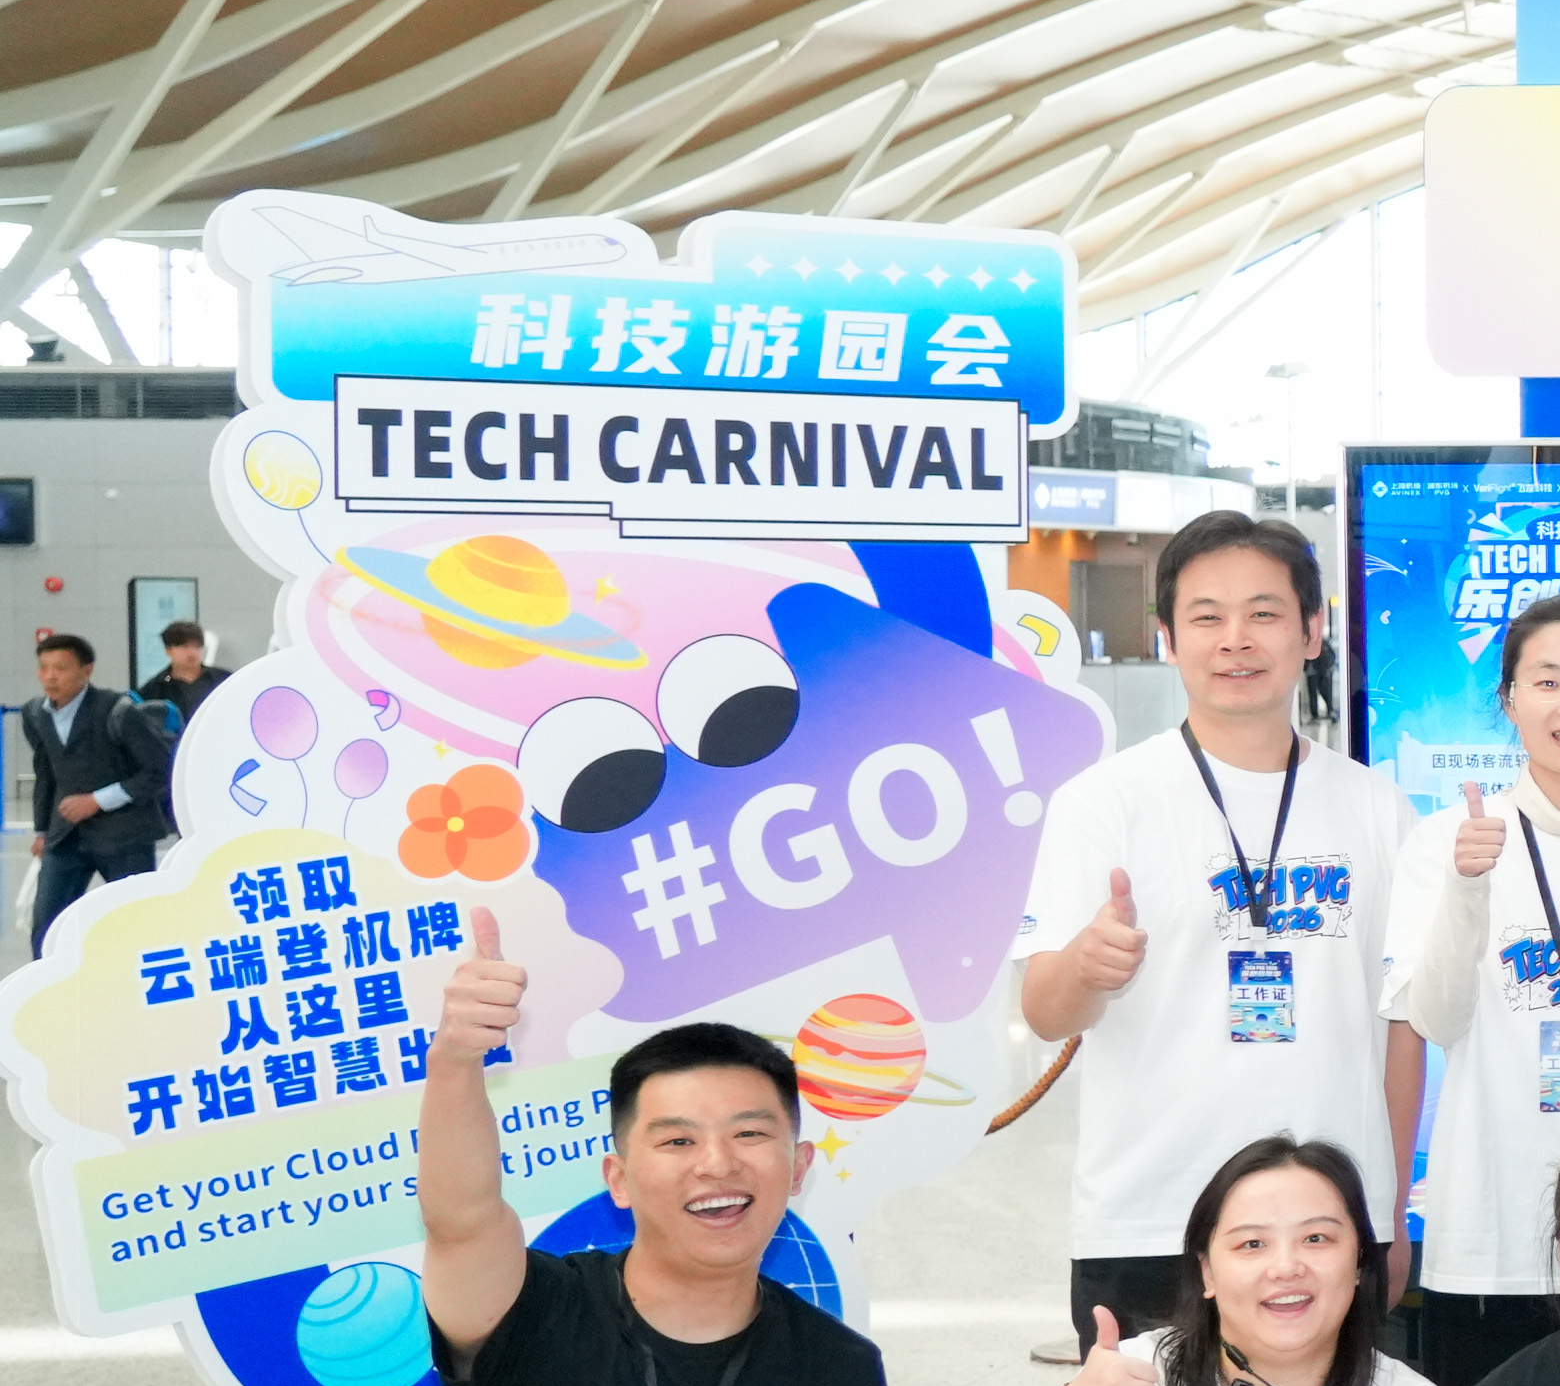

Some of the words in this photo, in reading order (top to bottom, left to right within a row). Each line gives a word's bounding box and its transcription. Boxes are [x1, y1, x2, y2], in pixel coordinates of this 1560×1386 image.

[470, 291, 1011, 387] 科技游园会
[356, 408, 570, 483] TECH
[598, 414, 1003, 492] CARNIVAL
[1478, 544, 1547, 574] TECH
[621, 707, 1045, 959] #GO!
[230, 854, 358, 925] 领取
[1288, 865, 1350, 906] PVG
[140, 900, 465, 1008] 云端登机牌
[1235, 986, 1287, 1002] 工作证
[221, 971, 410, 1055] 从这里
[102, 1183, 173, 1220] Get
[182, 1166, 275, 1211] your
[286, 1133, 399, 1180] Cloud
[111, 1222, 186, 1263] and
[199, 1199, 293, 1243] start
[303, 1180, 391, 1226] your
